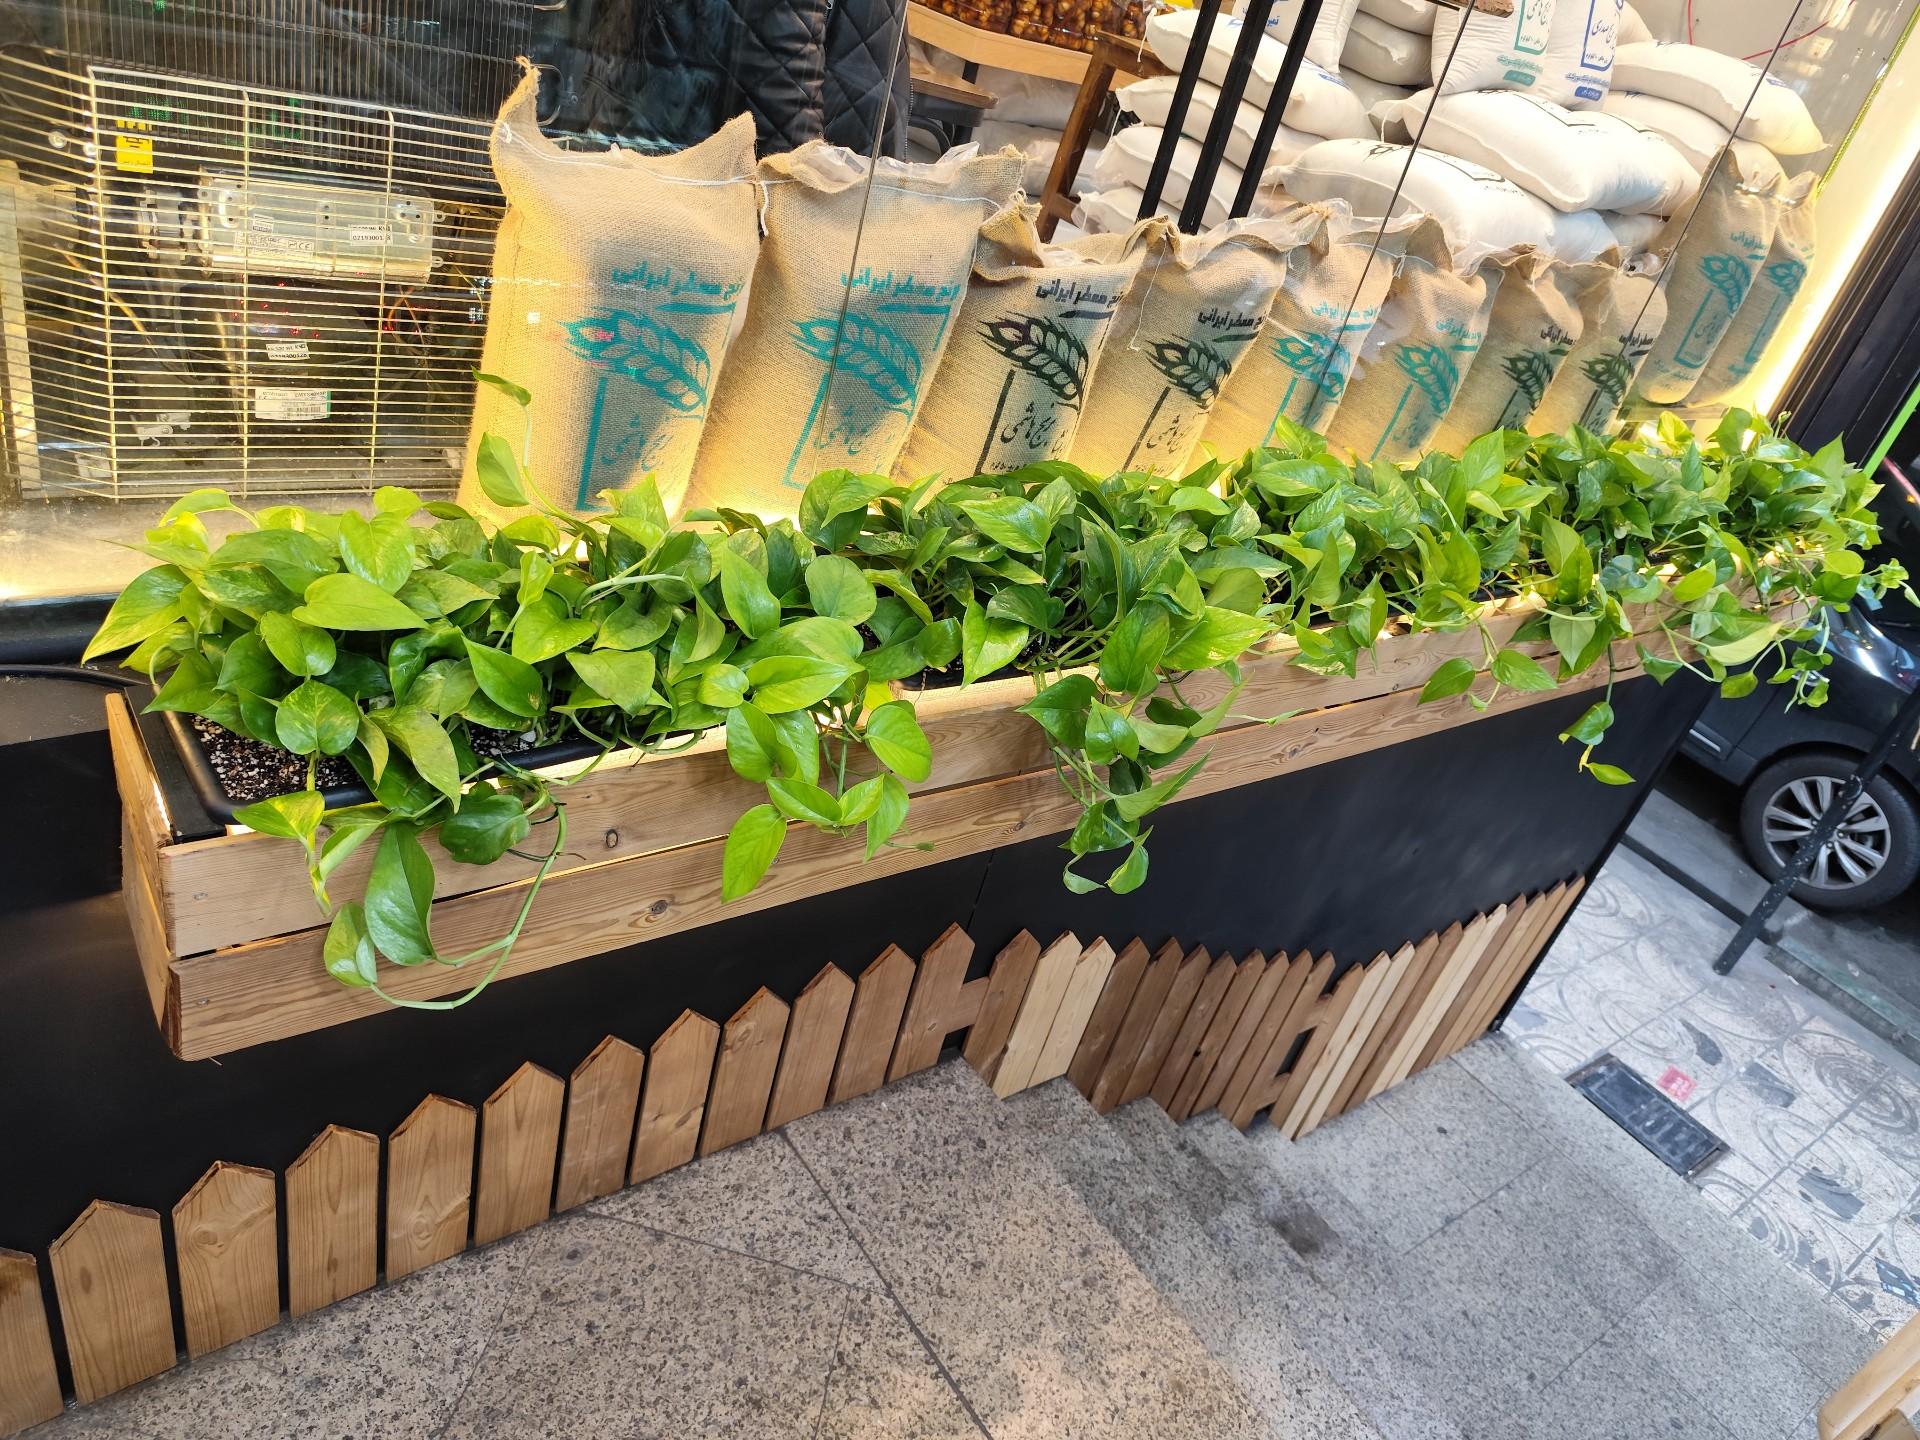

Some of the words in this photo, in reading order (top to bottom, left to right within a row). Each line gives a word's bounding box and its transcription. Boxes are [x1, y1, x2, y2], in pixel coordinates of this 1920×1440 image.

[612, 259, 672, 291] ایرانی
[1036, 279, 1076, 303] ایرانی
[1072, 284, 1107, 305] معطر
[1198, 308, 1230, 328] ایرانی
[1226, 312, 1254, 331] معطر
